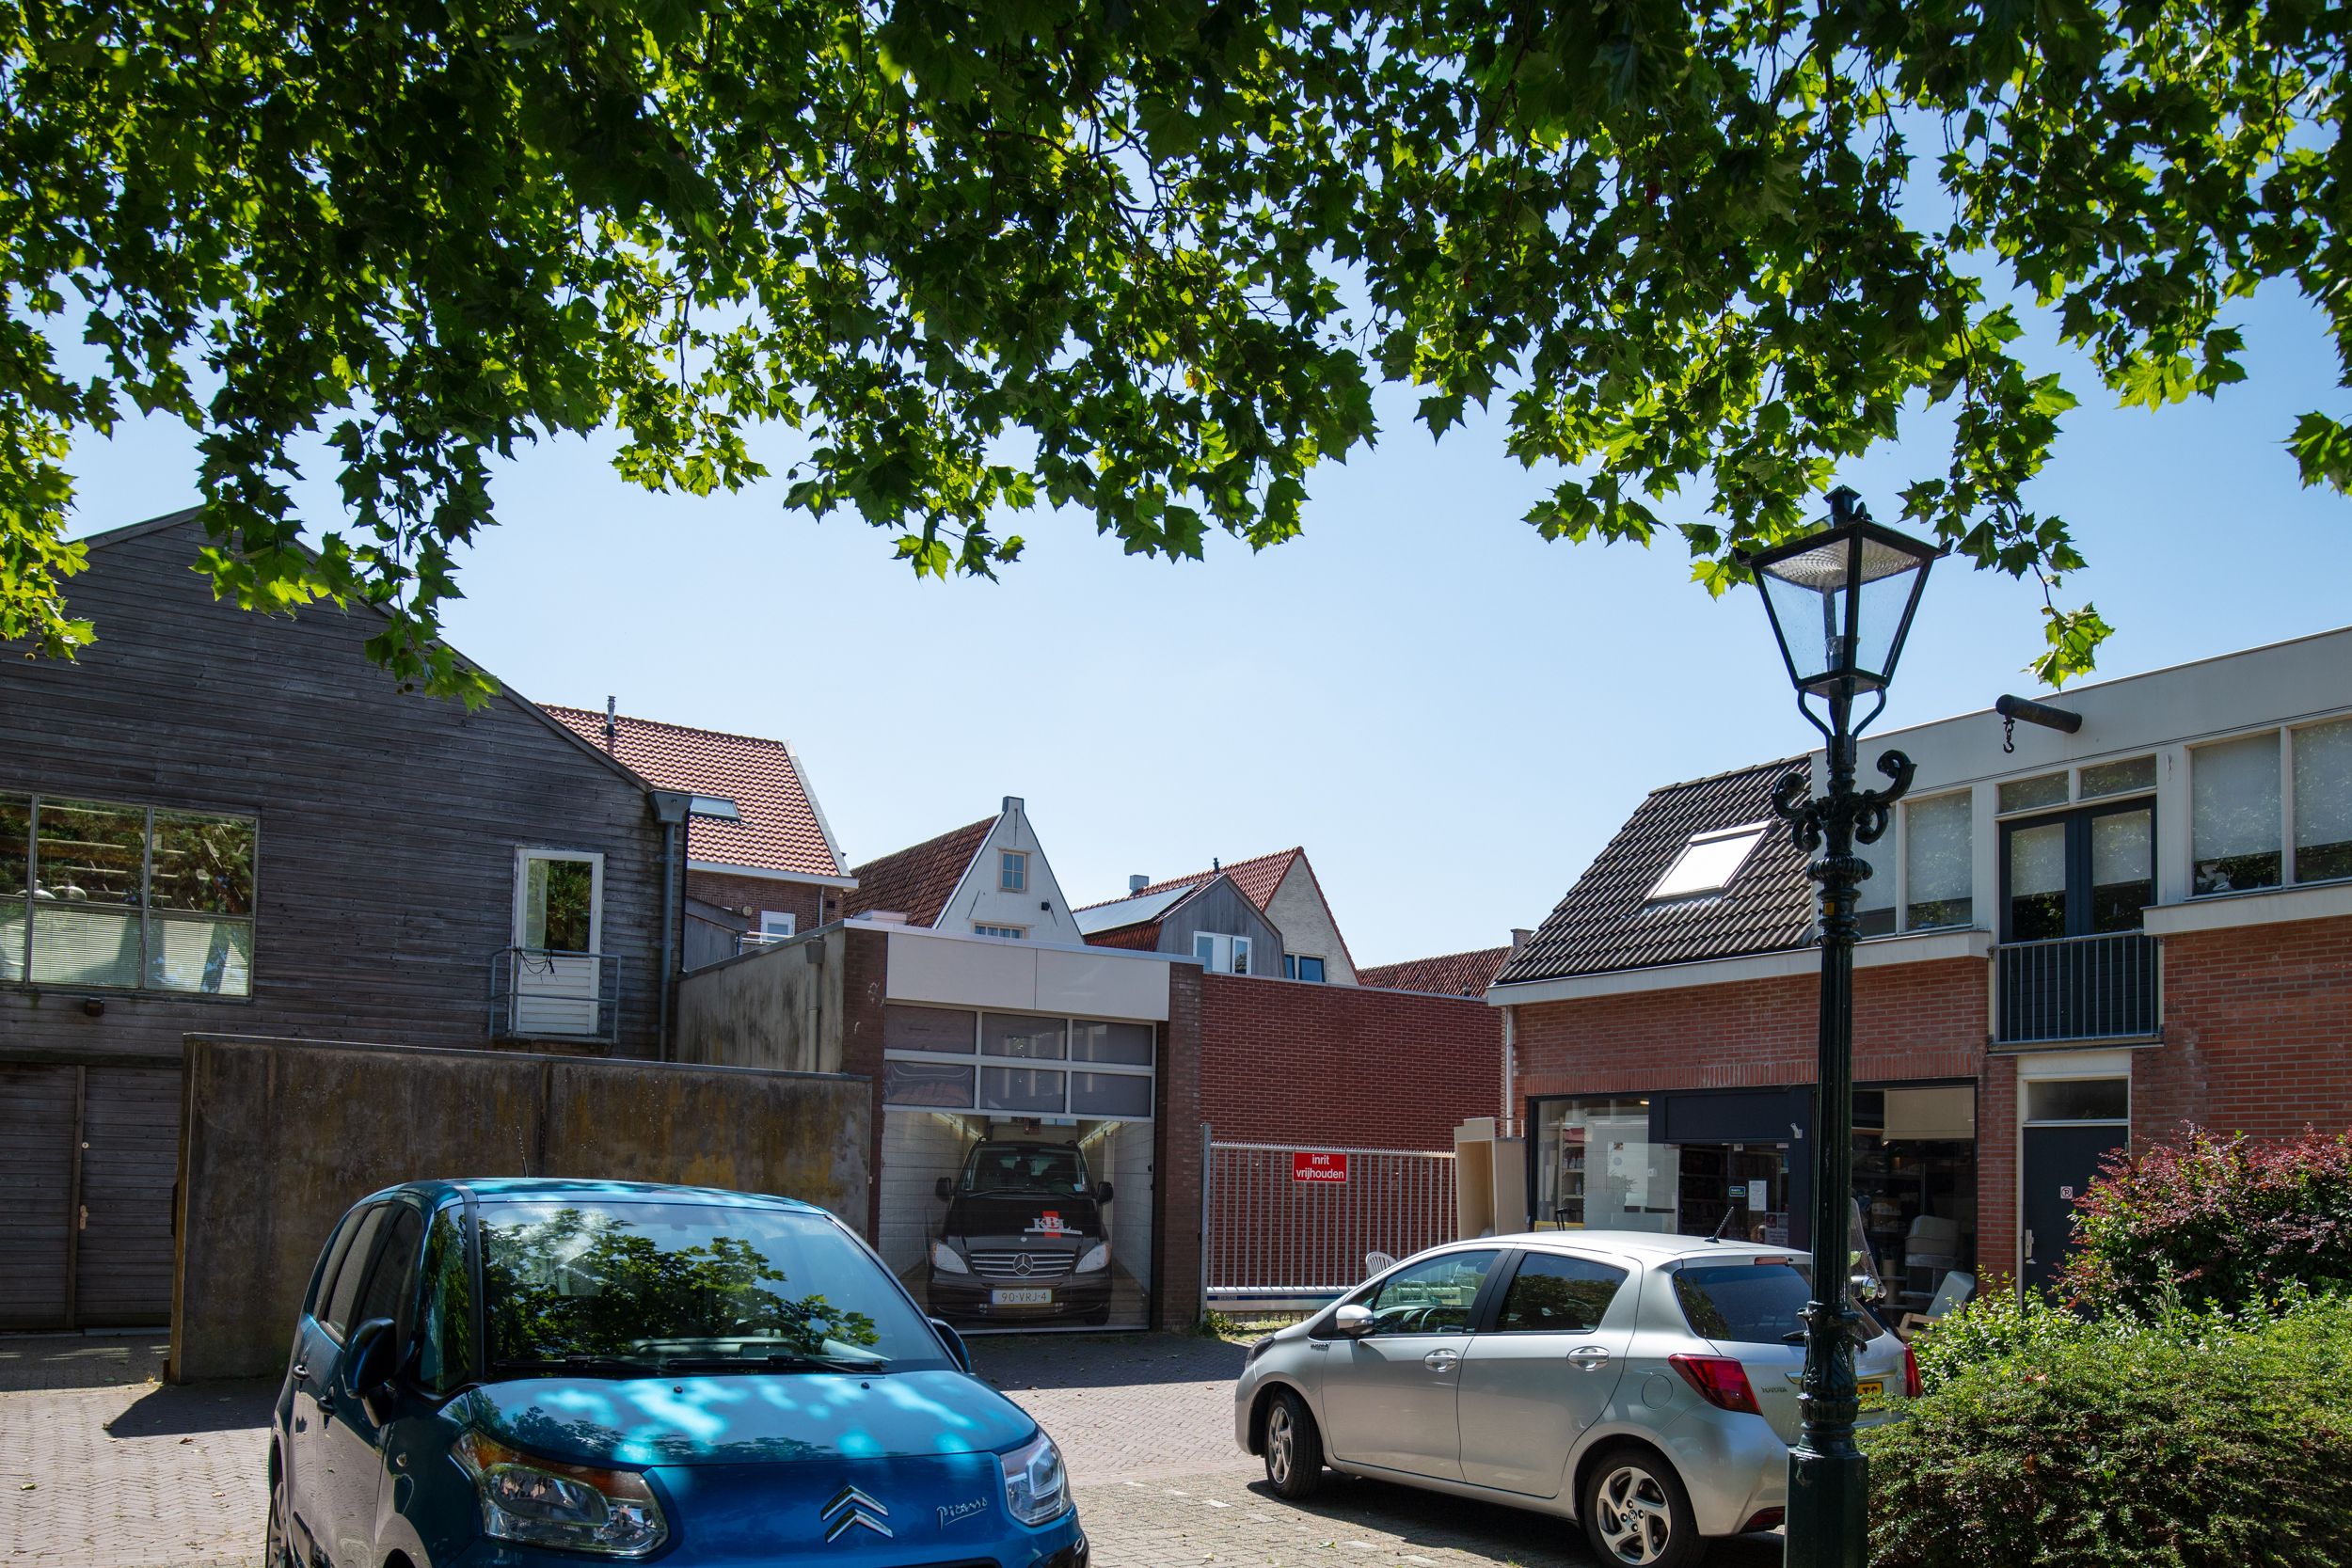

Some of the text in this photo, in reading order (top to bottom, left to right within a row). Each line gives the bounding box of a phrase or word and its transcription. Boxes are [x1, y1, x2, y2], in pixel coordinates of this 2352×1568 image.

[1311, 1153, 1330, 1165] inrit
[1295, 1167, 1345, 1180] vrijhouden
[1032, 1216, 1071, 1231] KBL
[1001, 1292, 1047, 1303] 90-VRJ-4
